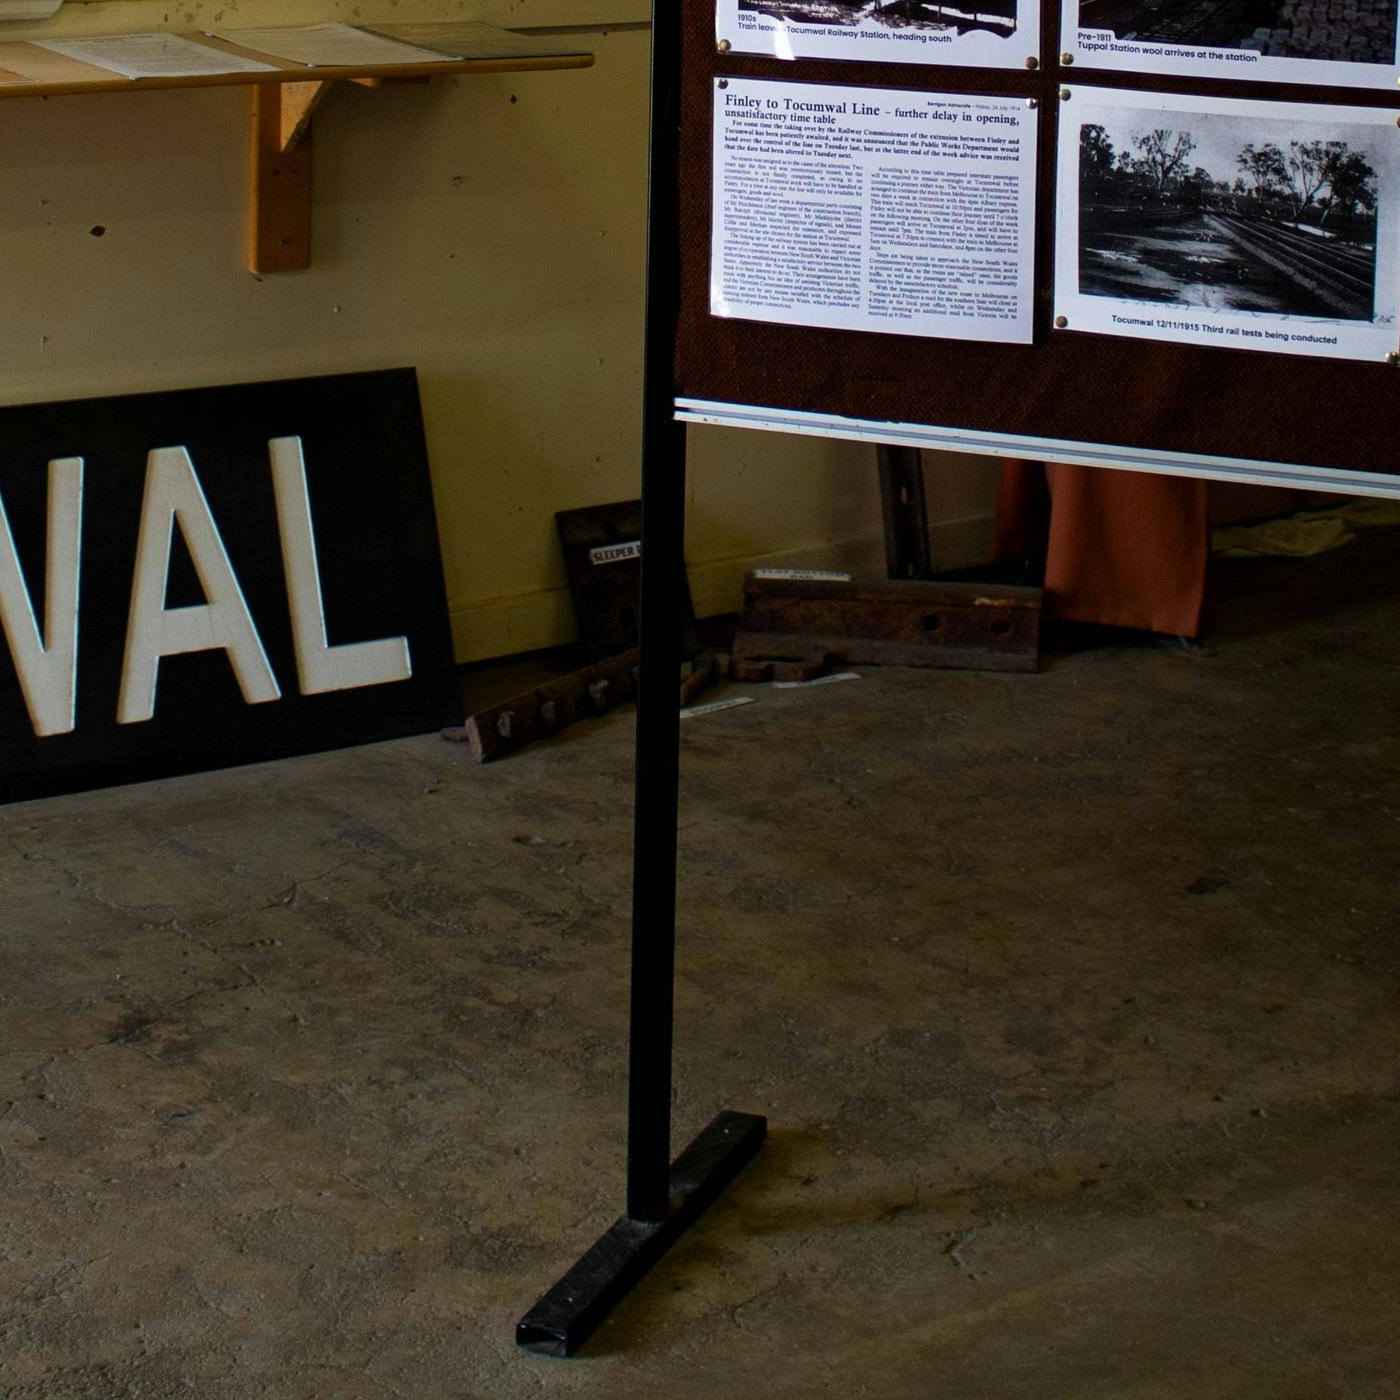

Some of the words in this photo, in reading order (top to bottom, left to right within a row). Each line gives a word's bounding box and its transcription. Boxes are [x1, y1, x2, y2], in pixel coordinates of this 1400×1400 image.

[1112, 315, 1154, 327] Tocumwal
[1156, 318, 1199, 332] 12/11/1915
[1202, 324, 1223, 334] Third
[1226, 326, 1239, 335] rail
[1241, 328, 1263, 337] tests
[1265, 330, 1289, 341] being
[1291, 333, 1337, 345] conducted
[594, 546, 634, 561] SLEEPER
